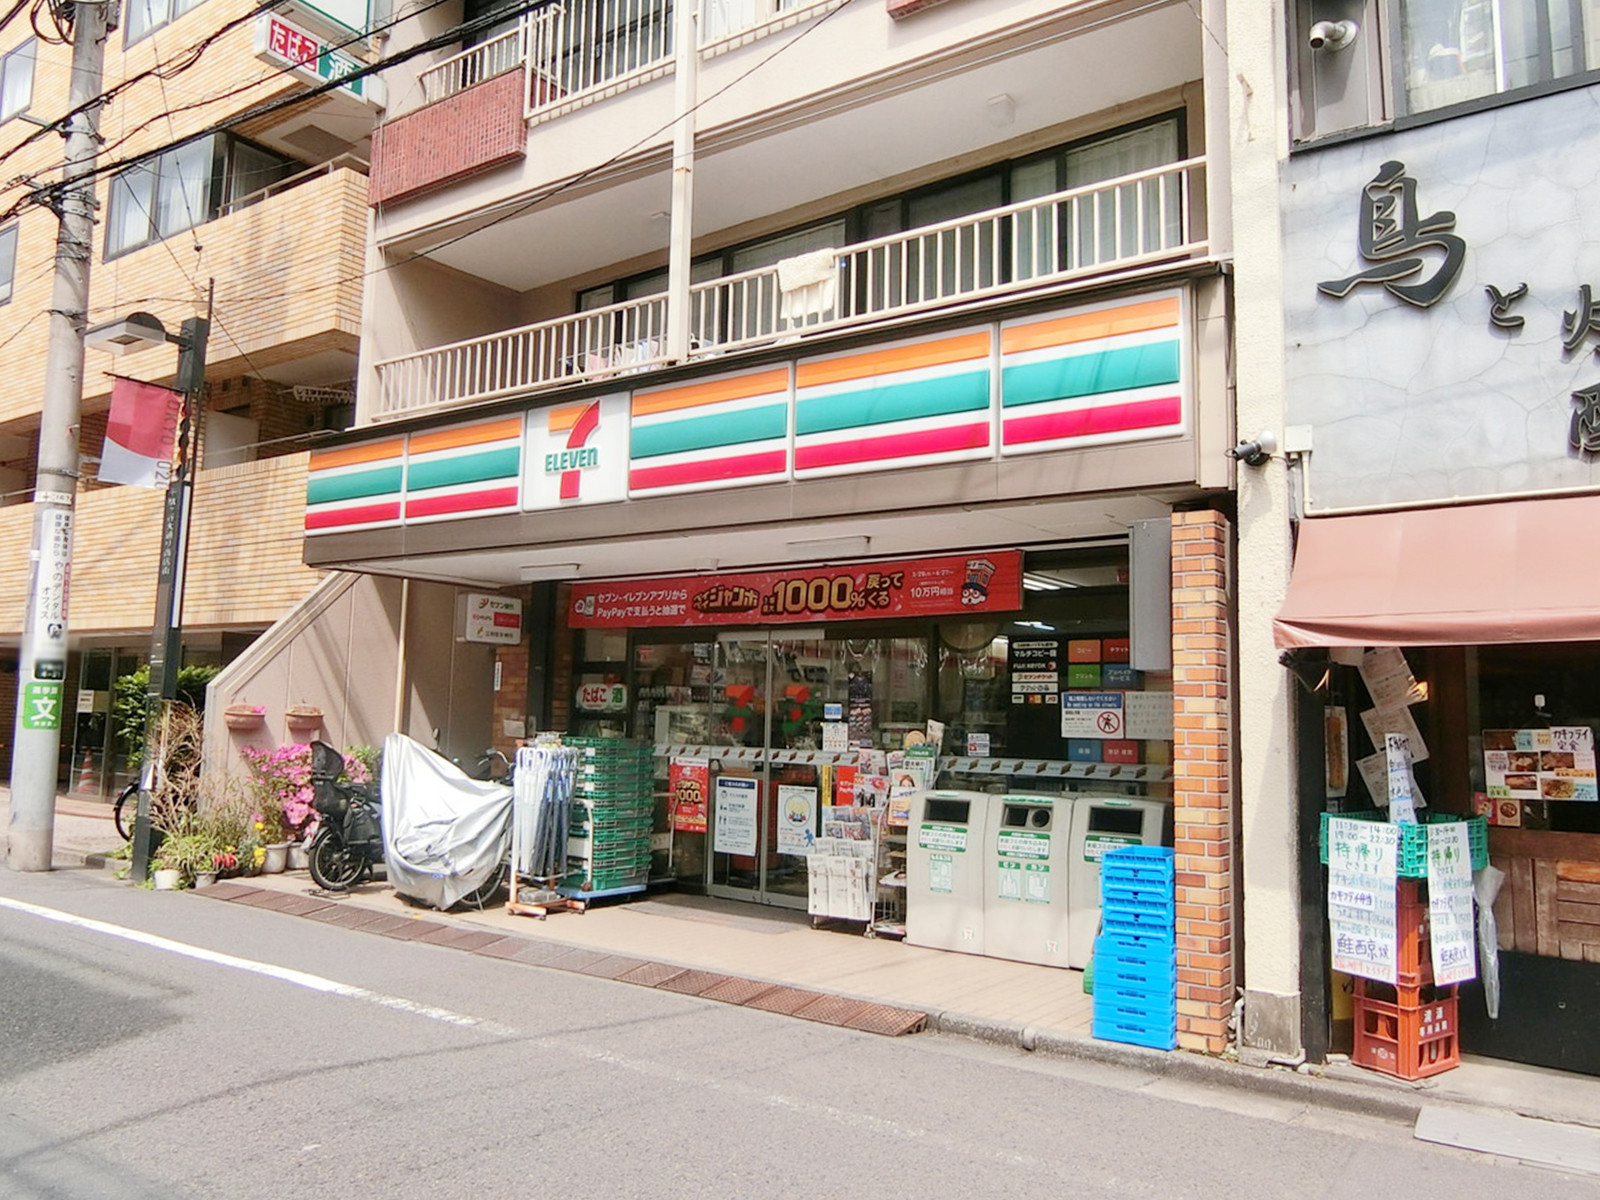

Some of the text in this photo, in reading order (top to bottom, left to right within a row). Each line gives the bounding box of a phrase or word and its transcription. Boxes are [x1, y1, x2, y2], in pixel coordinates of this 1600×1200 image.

[271, 22, 317, 70] たばこ
[327, 52, 360, 90] 酒
[866, 572, 904, 589] 戻って
[867, 590, 890, 606] くる
[583, 687, 607, 702] たばこ
[612, 687, 623, 703] 酒
[30, 696, 57, 720] 文
[1553, 729, 1589, 740] カキフライ
[1557, 740, 1580, 751] 定食
[1335, 842, 1383, 862] 持帰り
